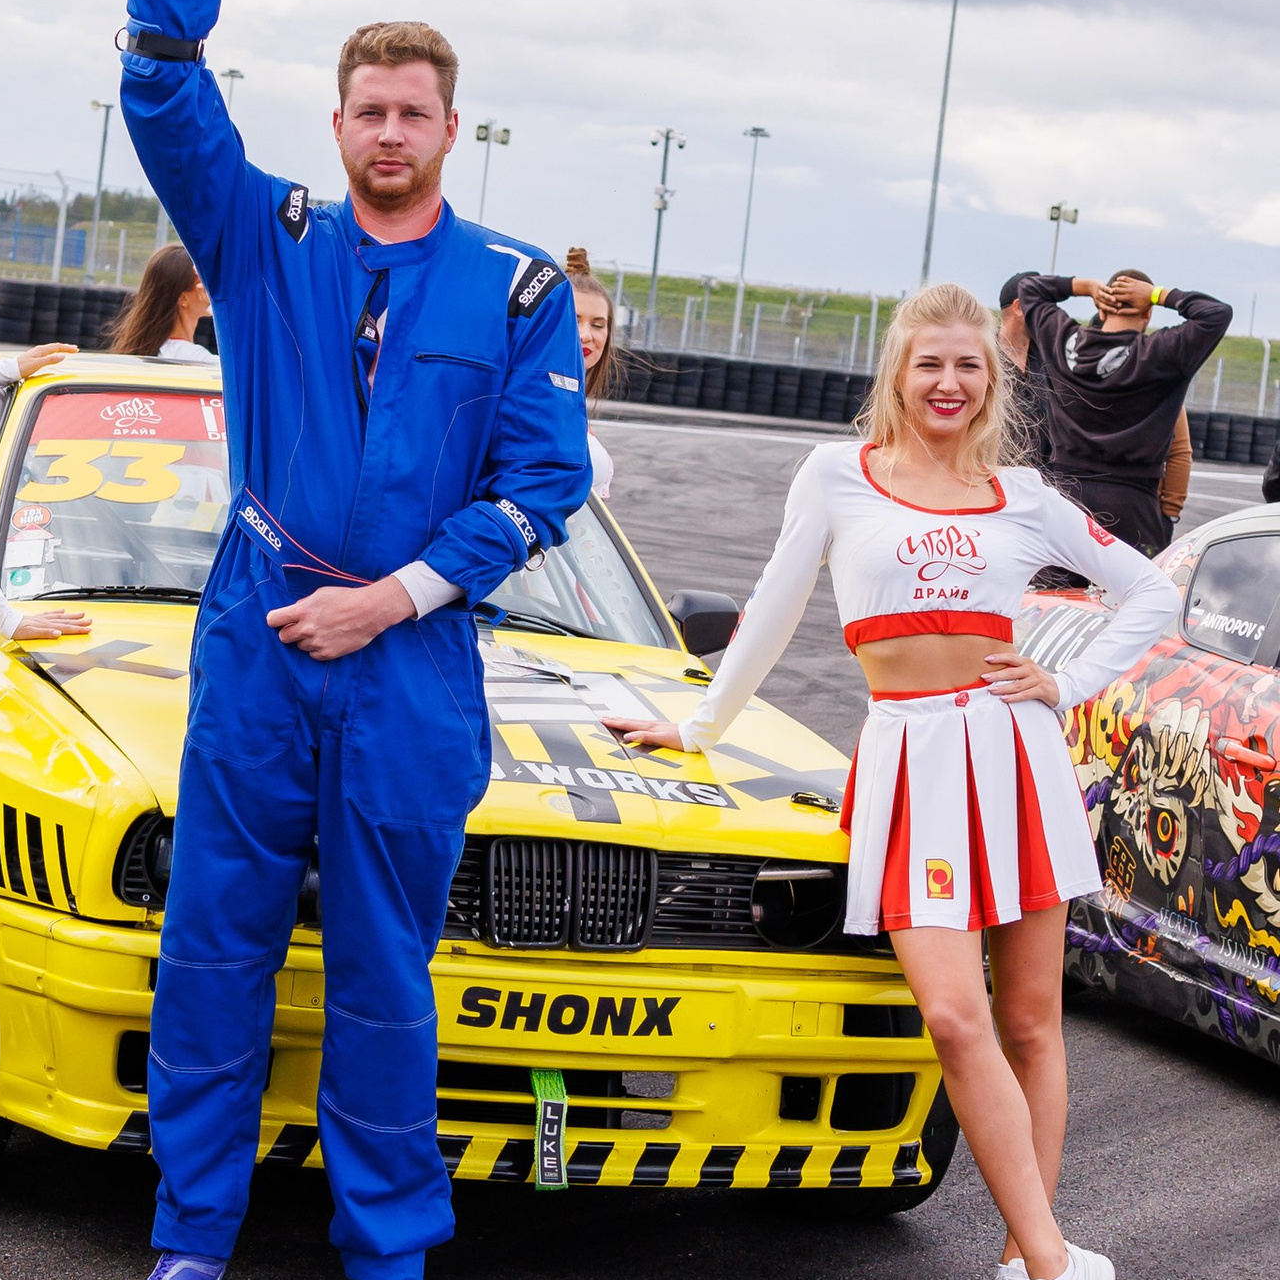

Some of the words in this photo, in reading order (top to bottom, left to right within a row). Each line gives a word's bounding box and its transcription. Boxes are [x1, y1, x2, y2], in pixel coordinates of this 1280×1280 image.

[287, 189, 305, 222] sparco
[518, 266, 555, 306] sparco
[113, 427, 157, 436] ДРАЙВ
[15, 440, 186, 504] 33
[242, 506, 282, 549] sparco
[499, 499, 537, 544] sparco
[913, 585, 970, 600] ДРАЙВ
[1201, 611, 1255, 638] ANTROPOV
[1254, 625, 1266, 641] S
[520, 762, 728, 807] WORKS
[1157, 906, 1199, 939] SECRETS
[456, 986, 682, 1037] SHONX
